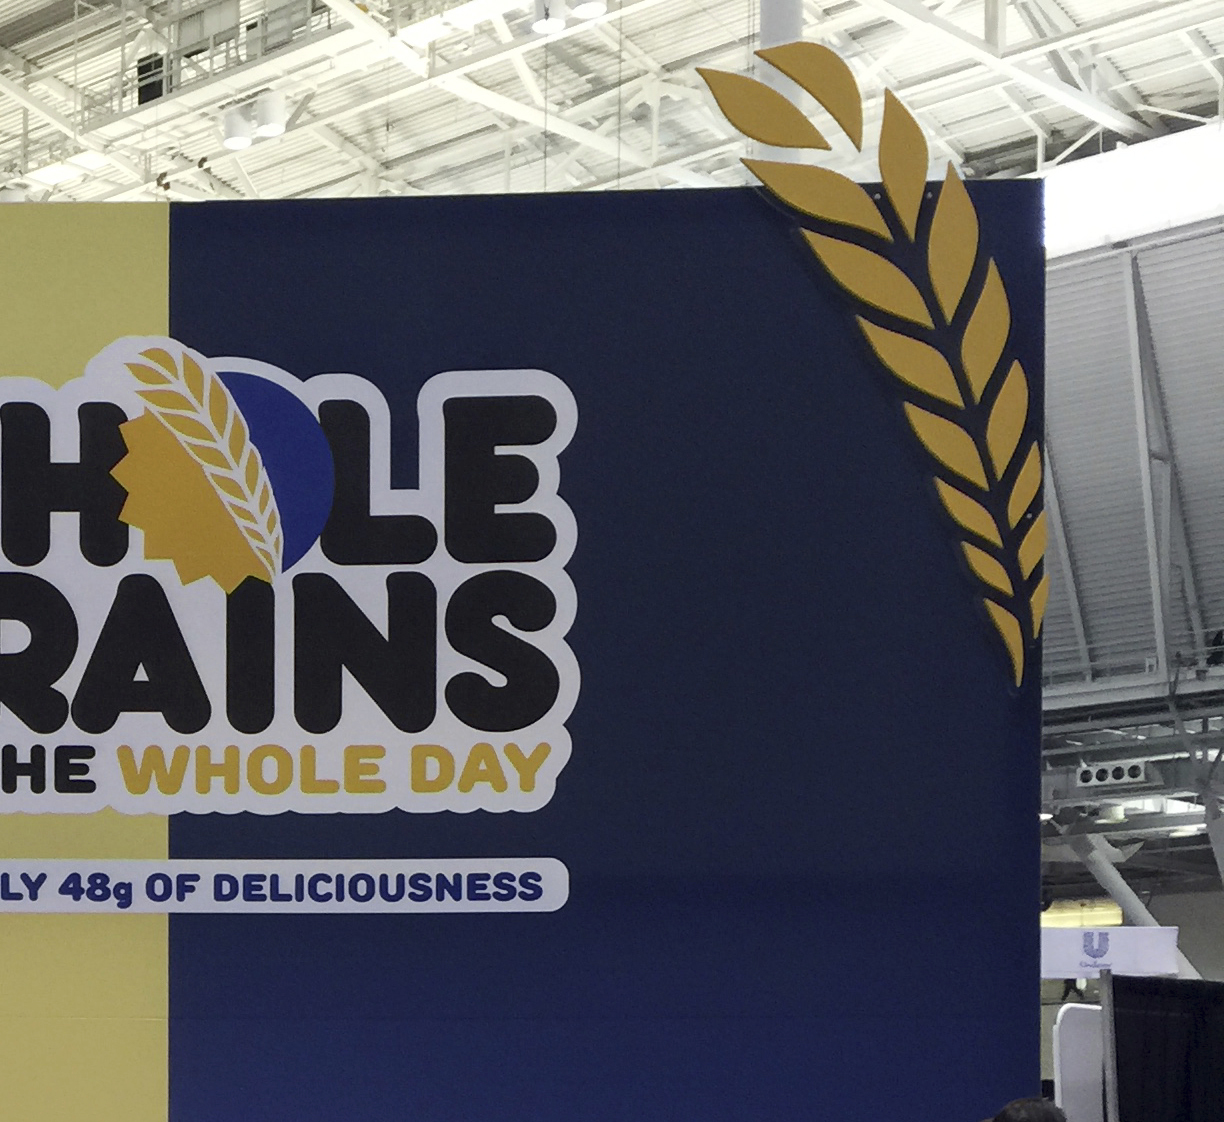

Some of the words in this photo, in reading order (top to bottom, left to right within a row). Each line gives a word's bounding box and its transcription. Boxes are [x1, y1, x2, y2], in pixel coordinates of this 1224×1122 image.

[117, 744, 386, 795] WHOLE
[411, 742, 552, 794] DAY
[59, 872, 134, 908] 48g
[145, 872, 197, 902] OF
[213, 870, 544, 902] DELICIOUSNESS
